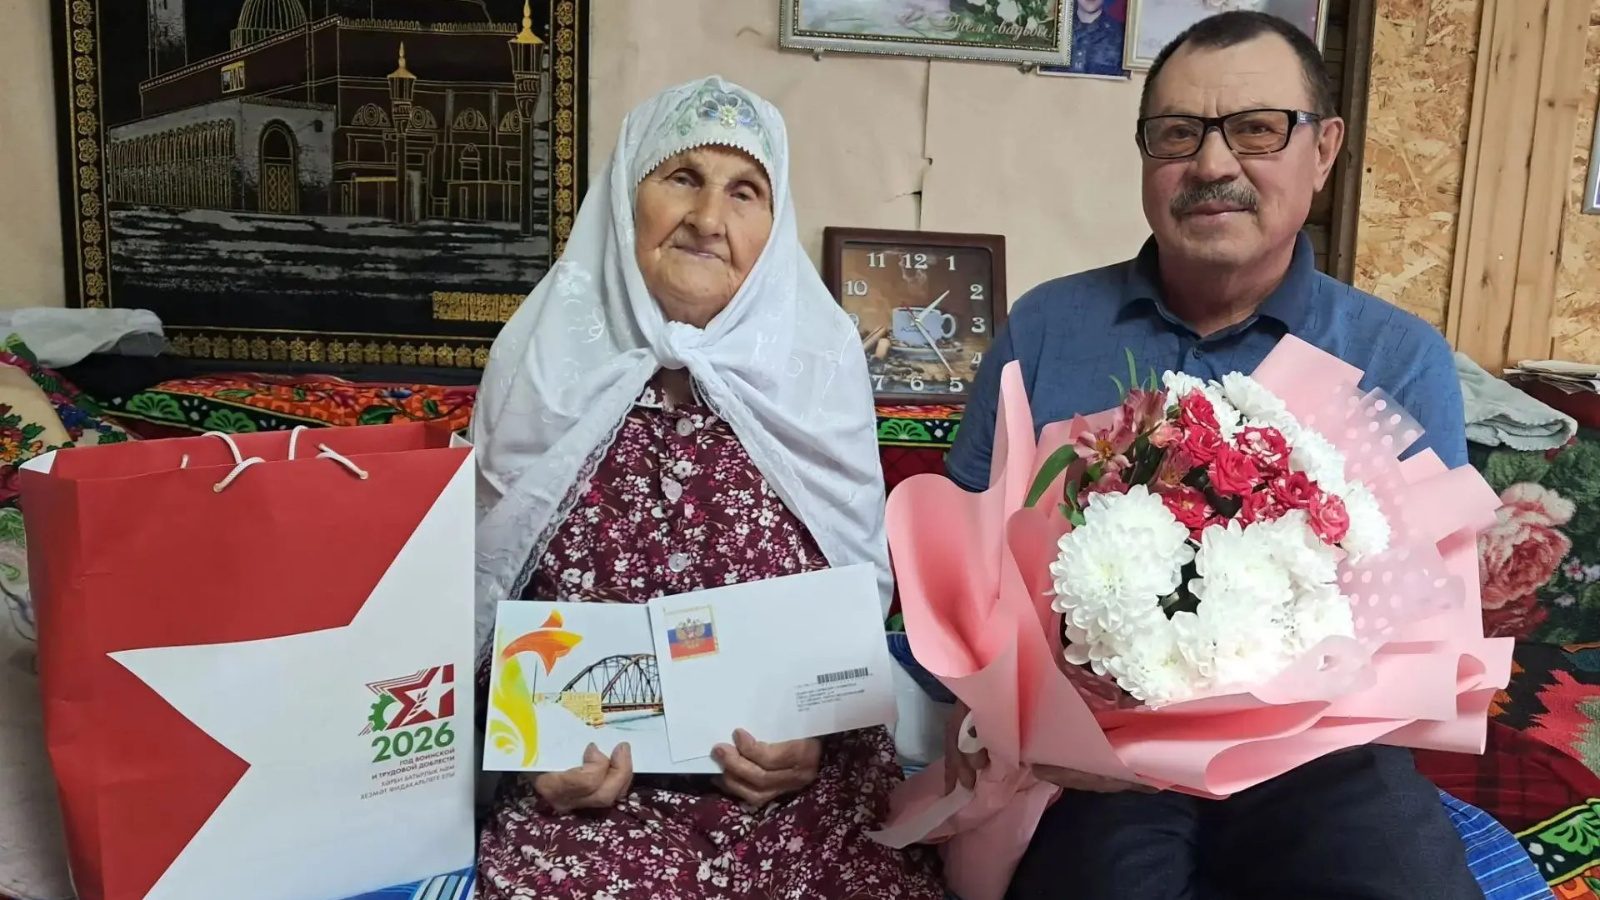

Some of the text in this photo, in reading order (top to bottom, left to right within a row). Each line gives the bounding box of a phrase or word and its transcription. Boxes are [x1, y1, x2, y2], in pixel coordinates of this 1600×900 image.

[867, 253, 886, 268] 11
[903, 253, 928, 270] 12
[946, 256, 956, 271] 1
[845, 280, 868, 296] 10
[970, 284, 984, 300] 2
[971, 317, 986, 333] 3
[971, 352, 982, 368] 4
[872, 374, 885, 391] 7
[910, 375, 924, 391] 6
[949, 377, 964, 392] 5
[371, 721, 455, 763] 2026
[400, 747, 455, 766] ГОД ВОИНСКОЙ
[379, 764, 417, 778] ТРУДОВОЙ
[418, 756, 455, 769] ДОБЛЕСТИ
